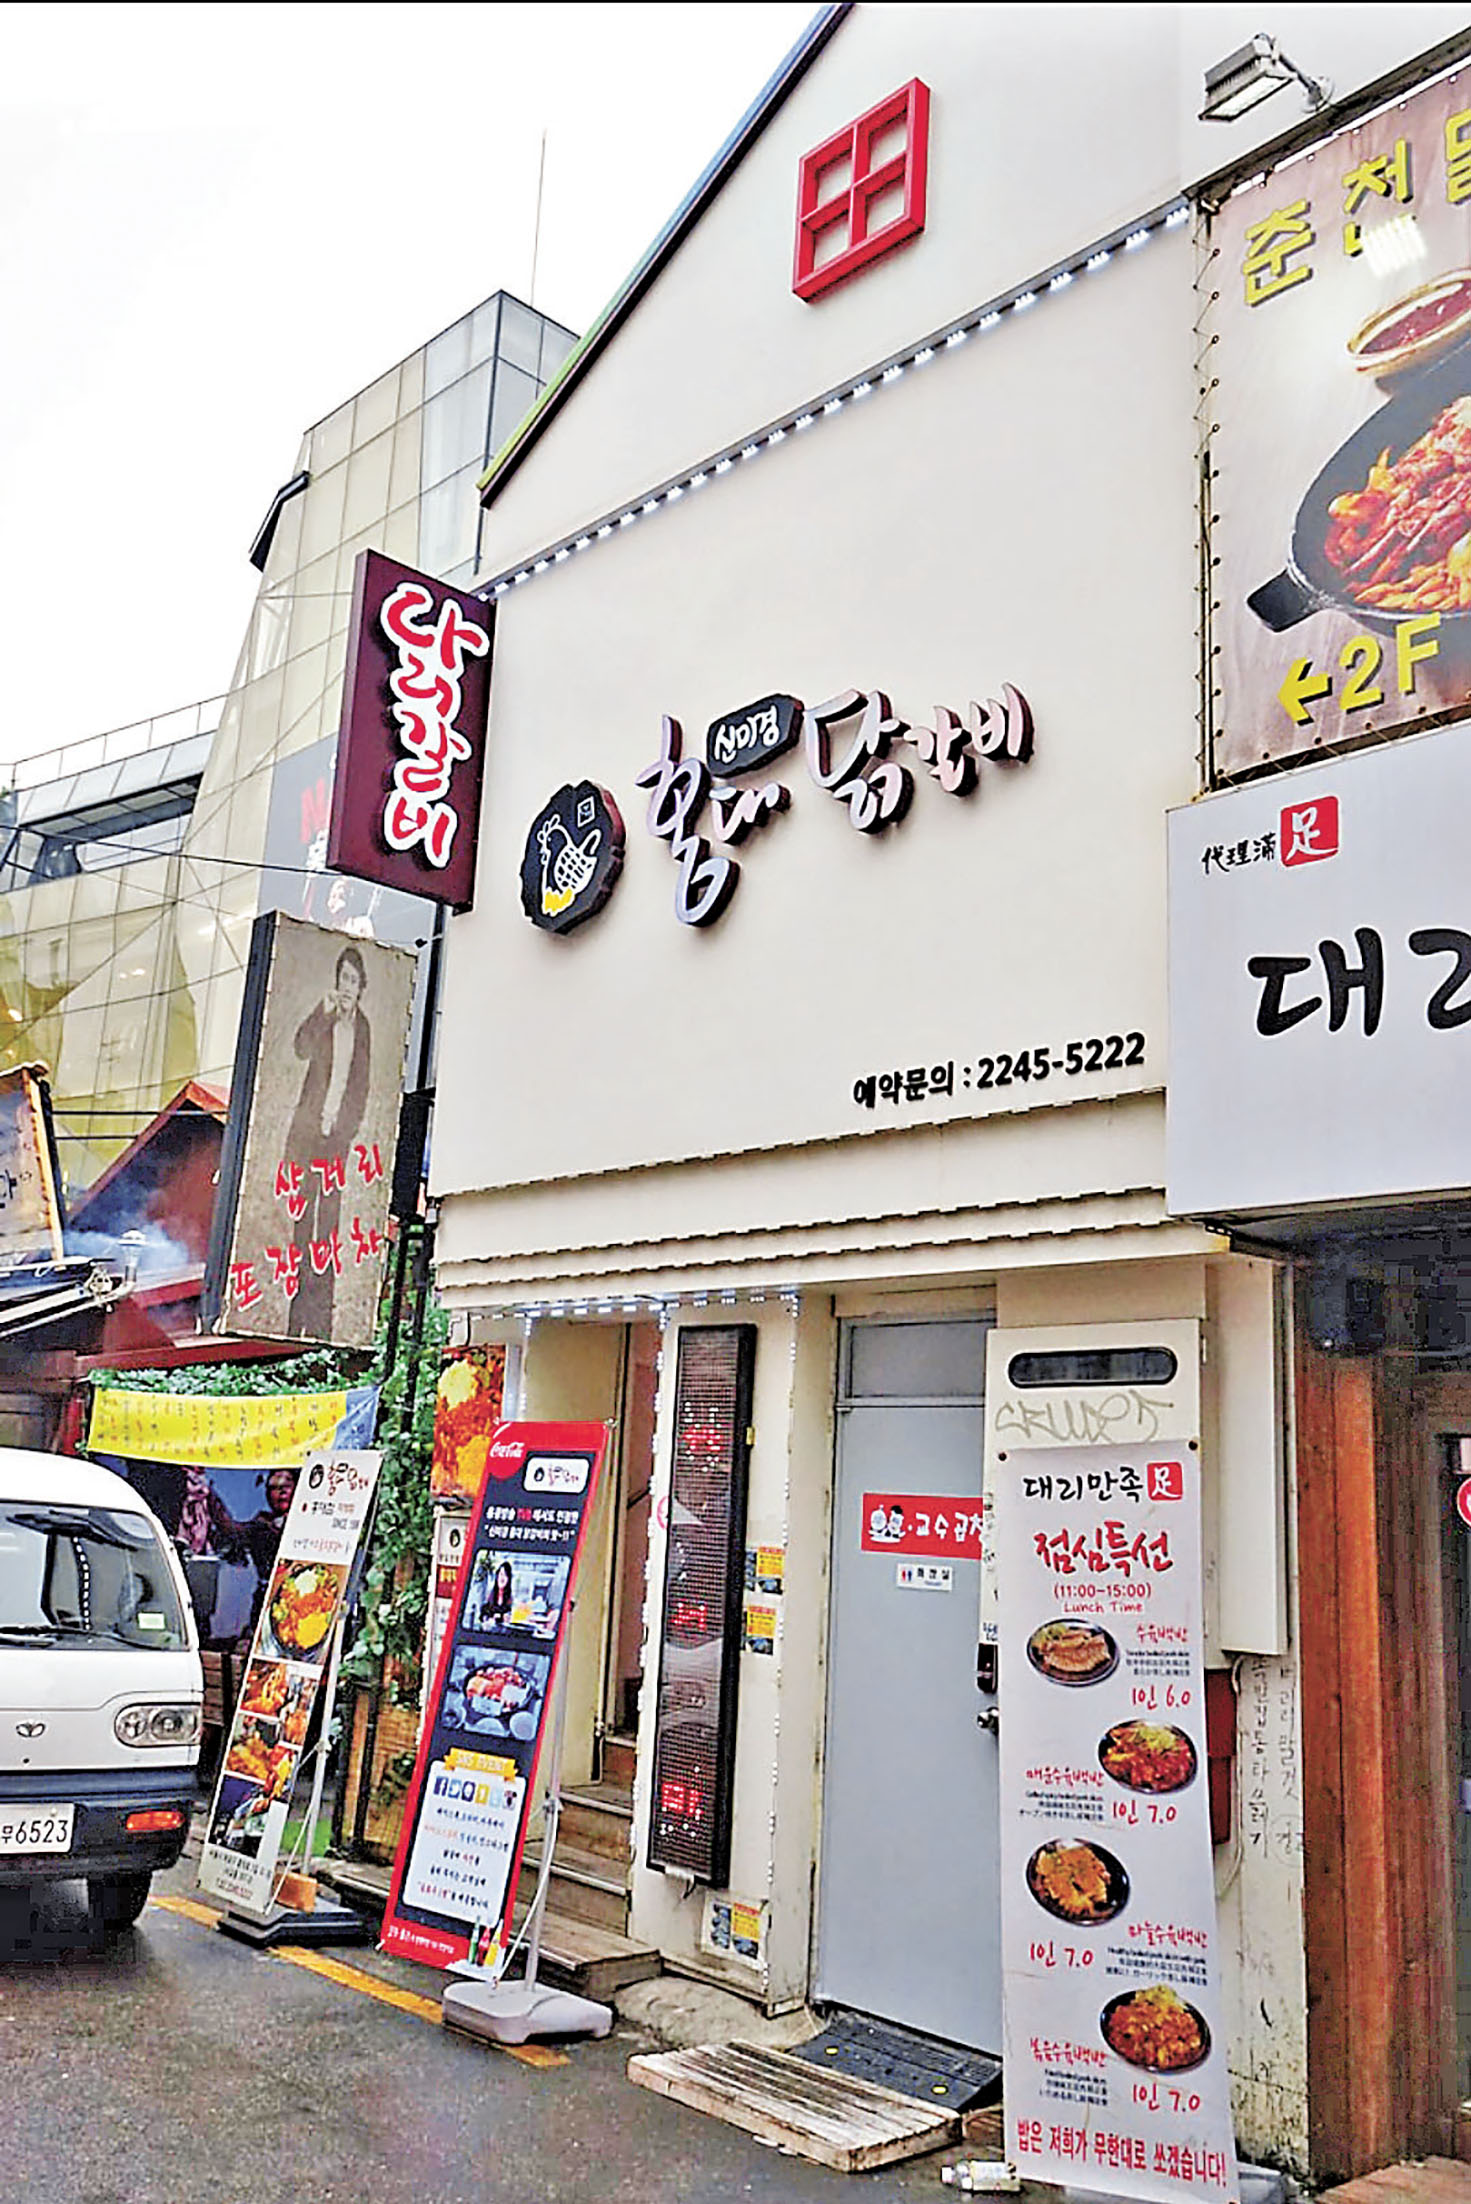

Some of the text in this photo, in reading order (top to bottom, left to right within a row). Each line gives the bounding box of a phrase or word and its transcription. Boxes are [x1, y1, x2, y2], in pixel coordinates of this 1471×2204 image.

[1338, 613, 1442, 713] 2F
[853, 1060, 955, 1109] 예약문의
[977, 1031, 1146, 1089] 2245-5222
[231, 1216, 384, 1312] 포장마차
[1023, 1467, 1143, 1502] 대리만족
[1034, 1520, 1174, 1578] 점심특선
[1064, 1601, 1143, 1613] Lunch Time
[1166, 1684, 1191, 1708] 6.0
[1146, 1804, 1177, 1823] 7.0
[1064, 1947, 1094, 1967] 7.0
[1168, 2090, 1201, 2111] 7.0
[1017, 2119, 1042, 2153] 밥은
[1049, 2126, 1088, 2163] 저희가
[1094, 2132, 1147, 2171] 무한대로
